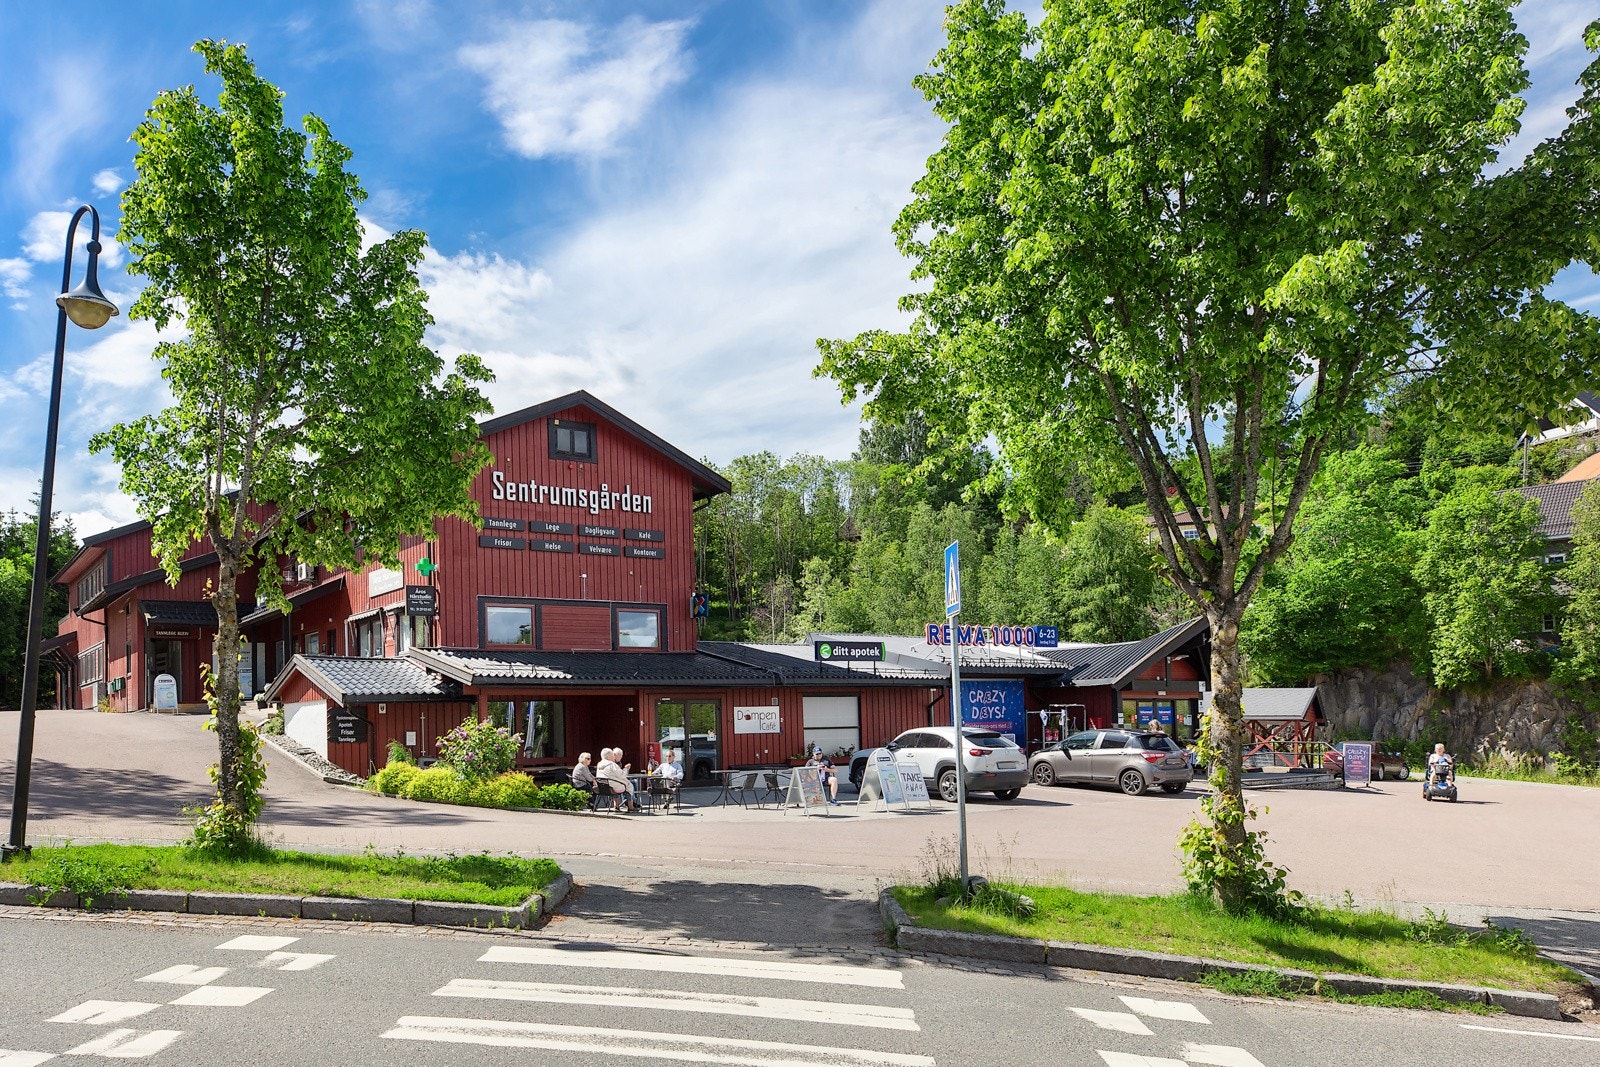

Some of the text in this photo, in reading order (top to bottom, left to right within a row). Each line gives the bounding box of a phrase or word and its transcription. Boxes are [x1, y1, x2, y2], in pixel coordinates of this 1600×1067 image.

[492, 471, 652, 514] Sentrumsgården
[489, 519, 517, 530] Tannlege
[545, 523, 560, 532] Lege
[584, 526, 615, 536] Dagligvare
[638, 531, 651, 539] Kafé
[544, 542, 561, 551] Helse
[589, 545, 612, 554] Velvære
[633, 548, 657, 557] Kontorer
[926, 623, 1036, 646] REMA 1000
[1039, 629, 1055, 639] 6-23
[833, 646, 880, 658] ditt apotek
[761, 721, 777, 730] Café
[900, 773, 922, 782] TAKE
[905, 783, 923, 792] AWAY
